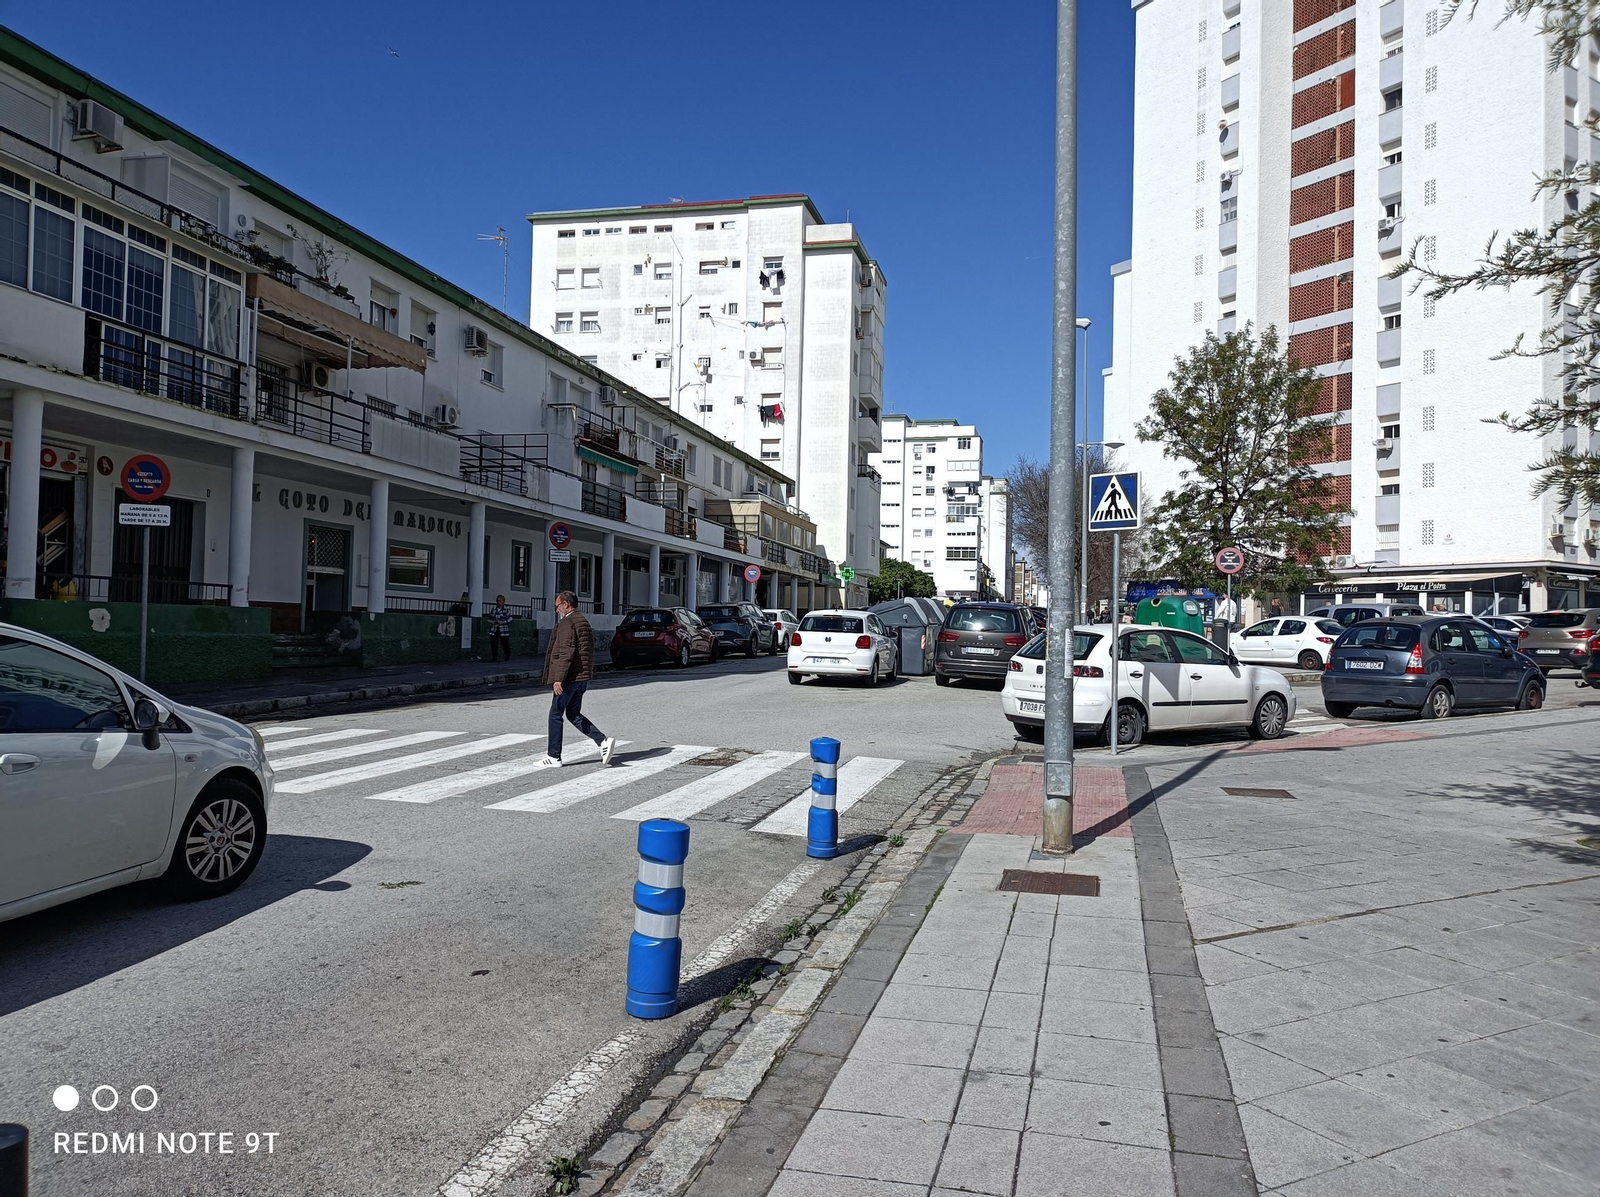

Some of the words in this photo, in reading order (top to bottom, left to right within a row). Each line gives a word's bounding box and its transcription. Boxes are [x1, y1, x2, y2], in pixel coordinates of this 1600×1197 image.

[343, 499, 371, 521] DE
[393, 510, 462, 539] MARQUES
[1396, 582, 1418, 591] Plaza
[1420, 582, 1426, 590] el
[1023, 702, 1038, 711] 7038
